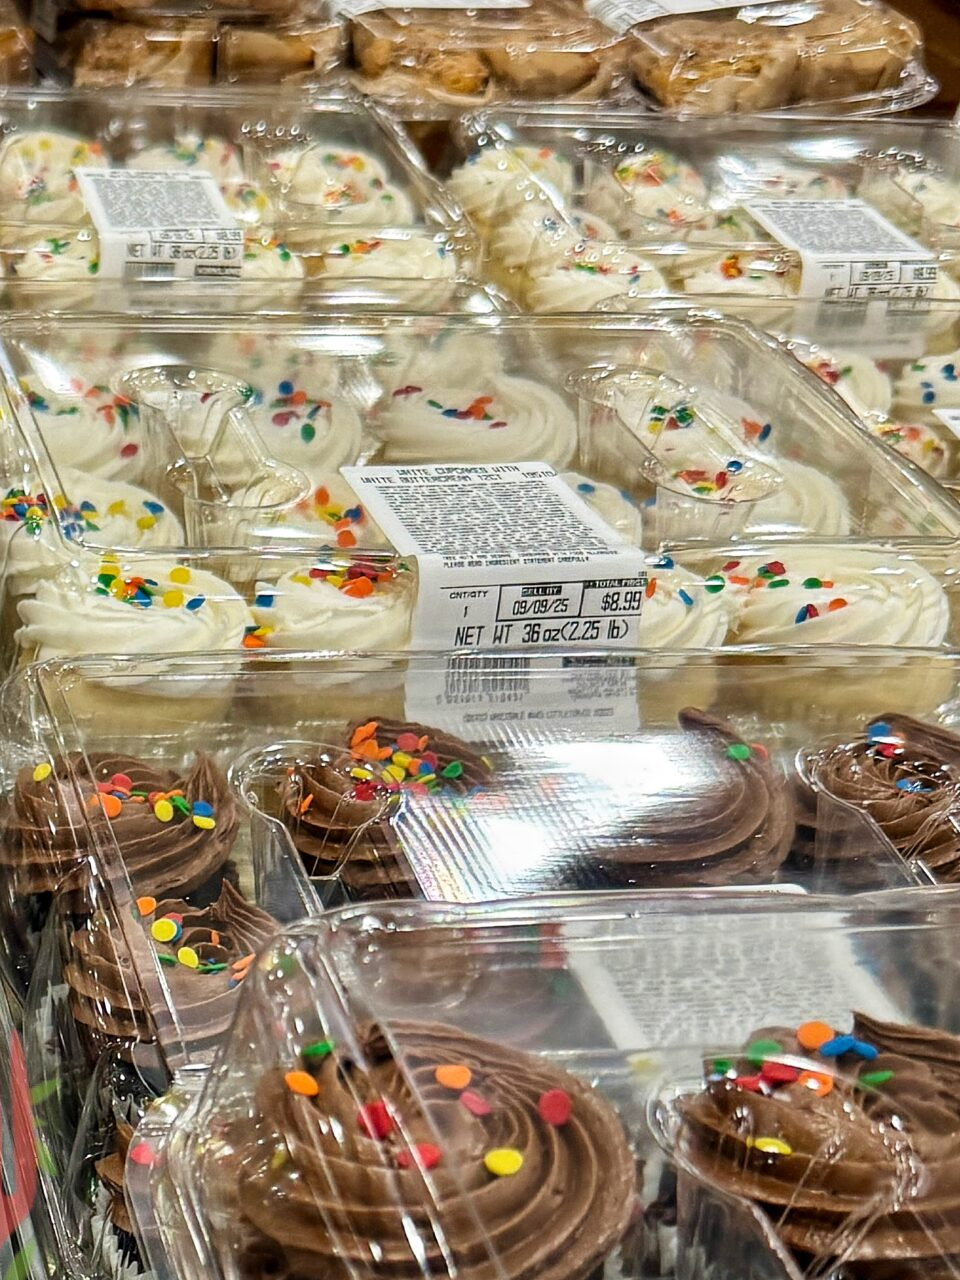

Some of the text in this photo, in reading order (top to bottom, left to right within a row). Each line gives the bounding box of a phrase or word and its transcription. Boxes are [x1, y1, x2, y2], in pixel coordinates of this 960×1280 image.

[513, 599, 569, 615] 09/09/25
[601, 591, 641, 611] $8.99
[455, 626, 485, 646] NET
[492, 624, 513, 644] WT
[608, 620, 629, 639] lb)
